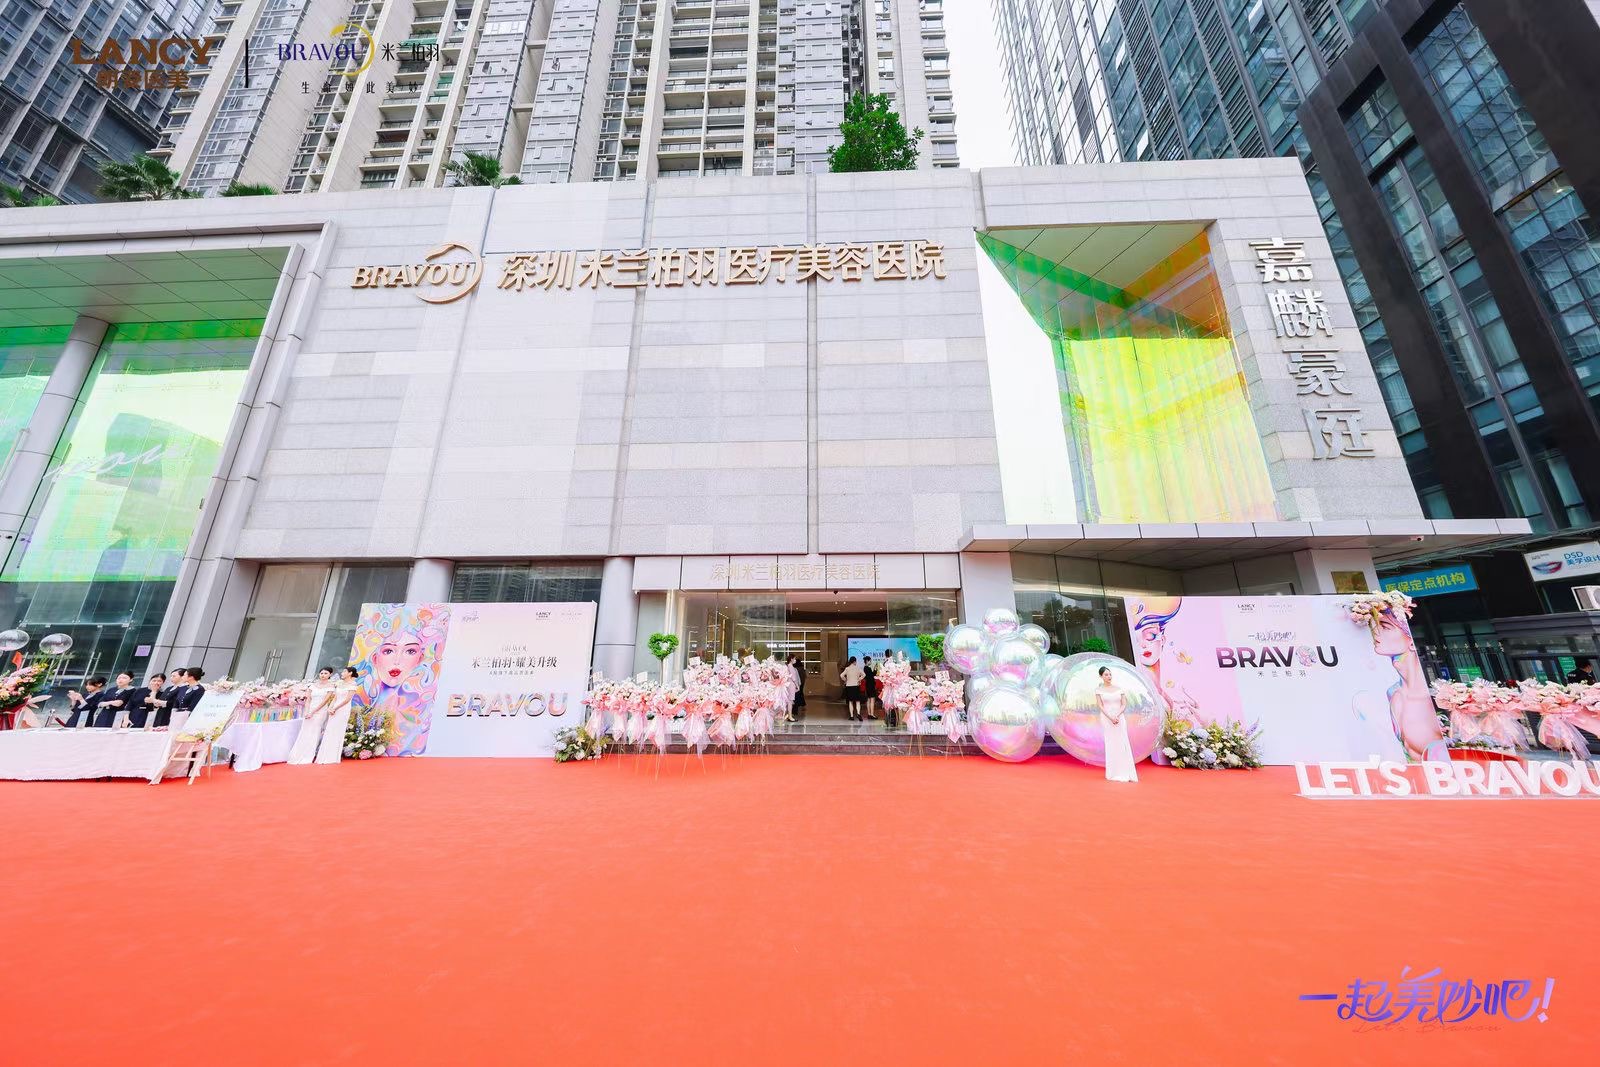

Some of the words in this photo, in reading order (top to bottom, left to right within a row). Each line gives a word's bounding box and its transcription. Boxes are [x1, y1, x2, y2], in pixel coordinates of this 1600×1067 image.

[351, 264, 473, 288] BRAVOU
[496, 239, 947, 291] 深圳米兰柏羽医疗美容医院
[1249, 237, 1376, 461] 嘉麟豪庭
[1563, 551, 1584, 560] DSD
[446, 692, 569, 718] BRAVOU
[1294, 754, 1412, 797] LET'S
